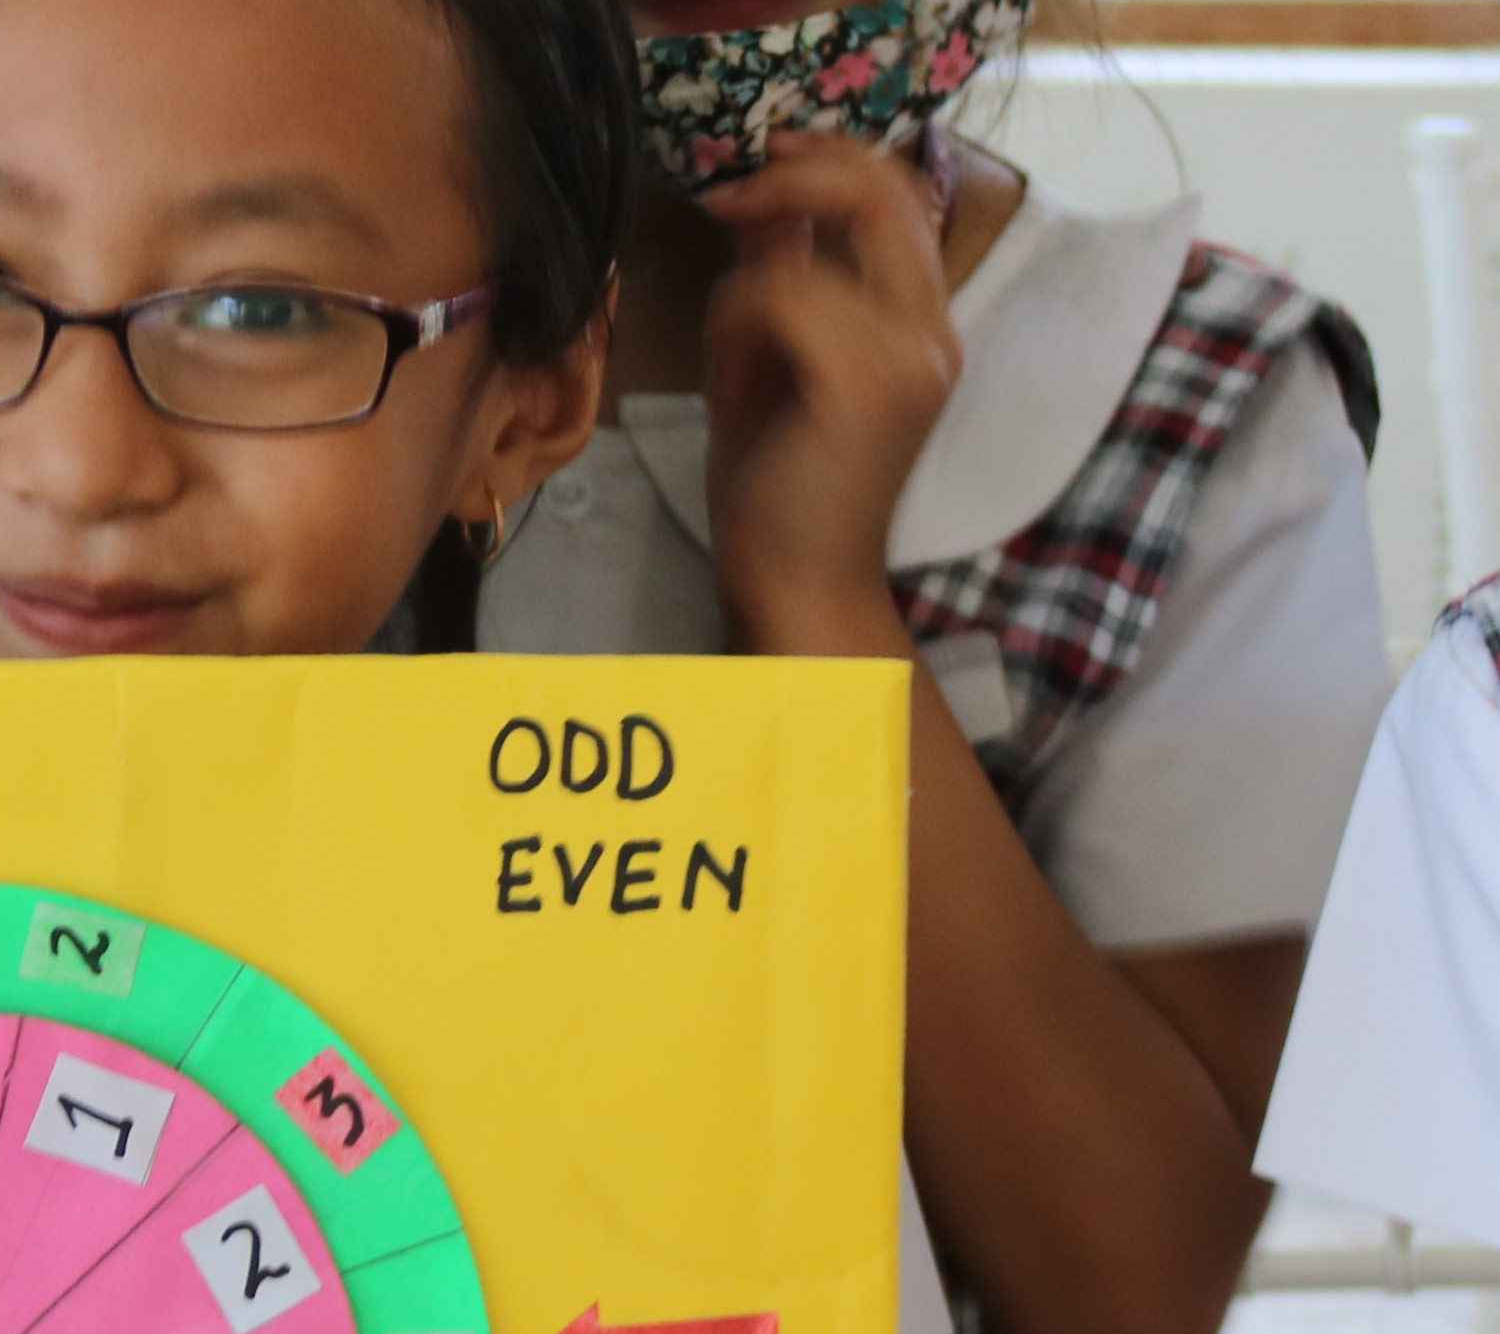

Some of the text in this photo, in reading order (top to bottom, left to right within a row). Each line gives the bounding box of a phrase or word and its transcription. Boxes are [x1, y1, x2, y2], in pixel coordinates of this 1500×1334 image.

[488, 714, 675, 802] ODD
[496, 835, 749, 916] EVEN
[49, 926, 111, 976] 2
[57, 1095, 134, 1159] 1
[302, 1076, 365, 1147] 3
[220, 1221, 291, 1301] 2
